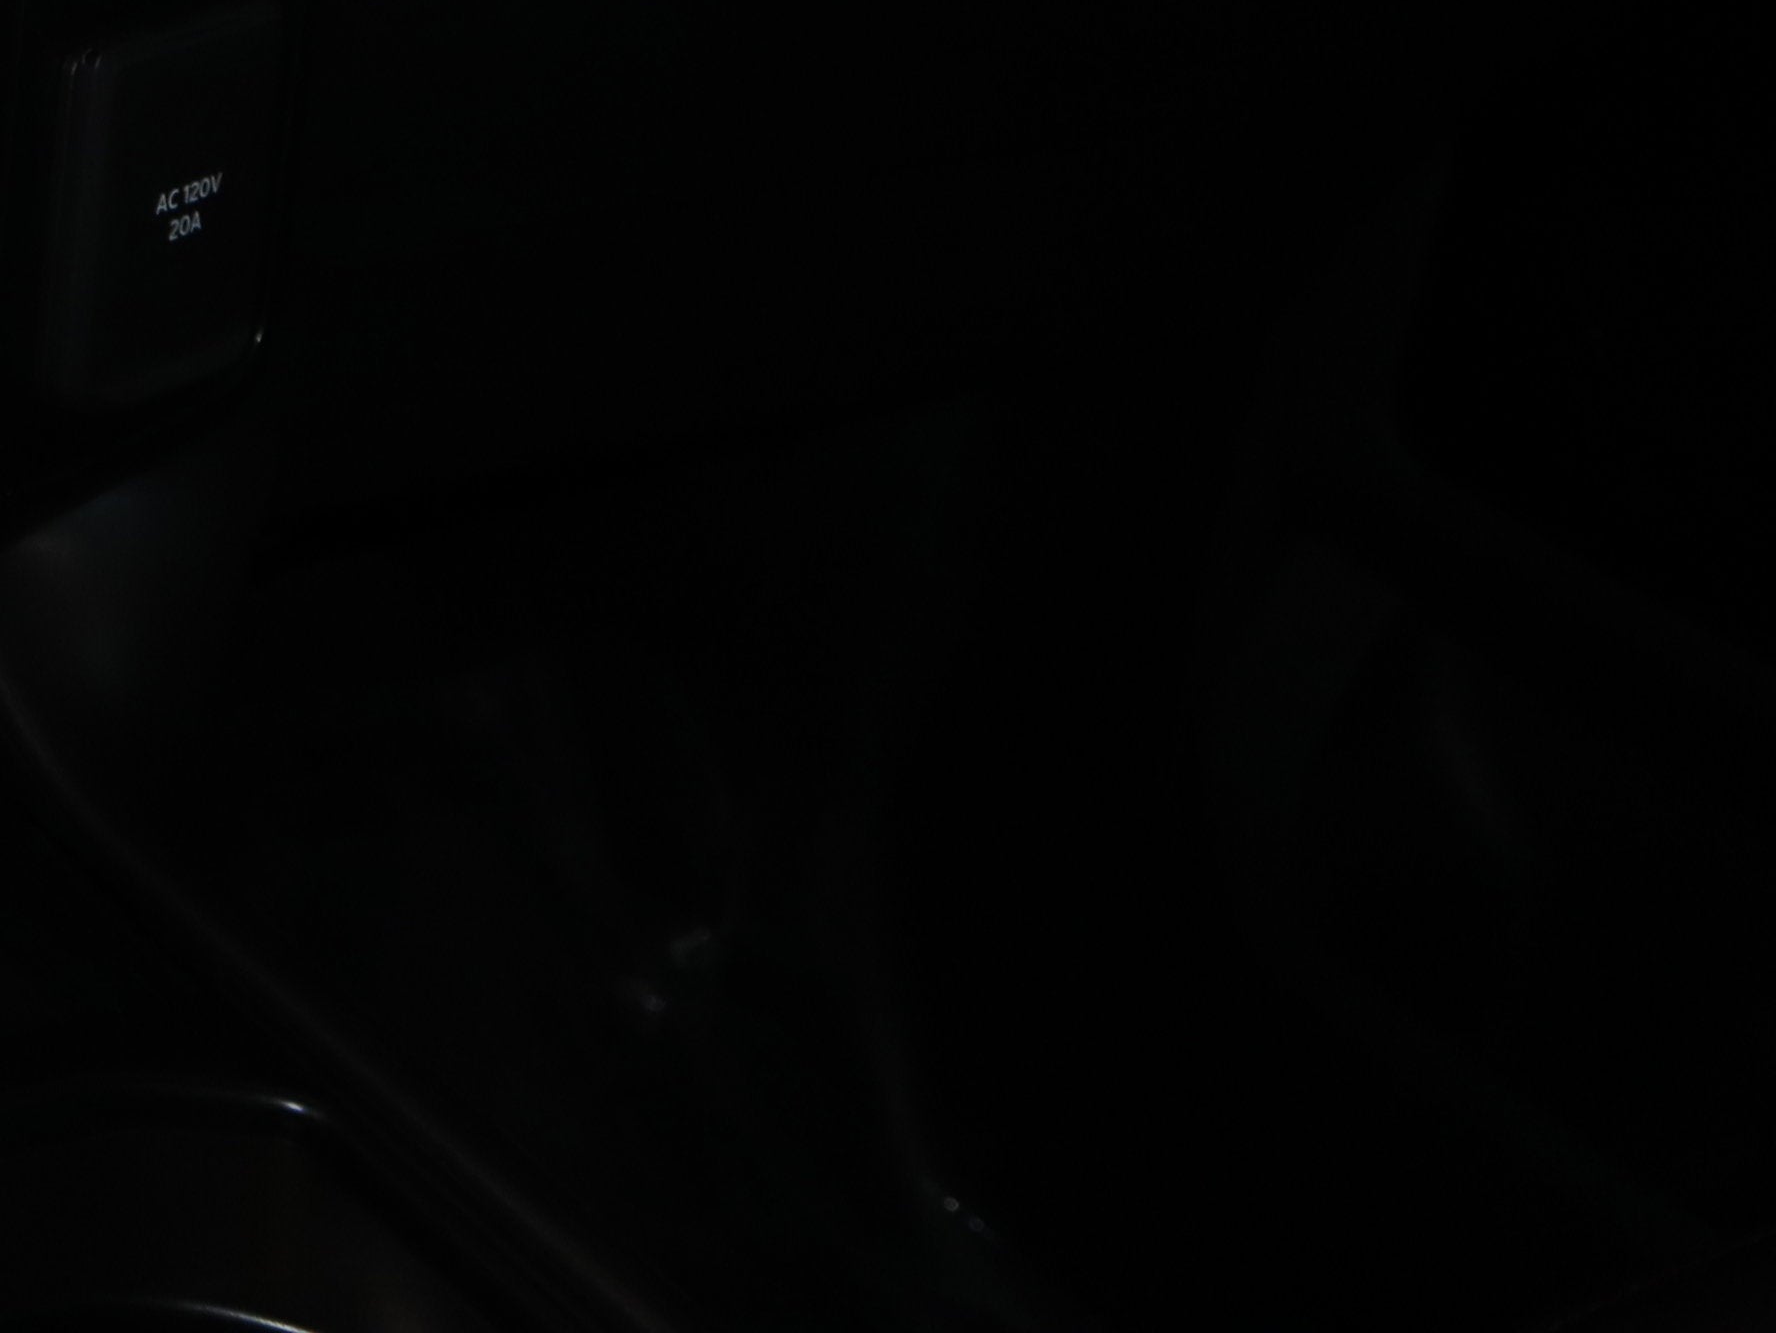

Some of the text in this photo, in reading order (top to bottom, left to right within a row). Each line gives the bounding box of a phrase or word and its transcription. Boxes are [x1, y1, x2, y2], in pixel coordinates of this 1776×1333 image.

[156, 171, 223, 216] AC 120V
[167, 211, 202, 241] 20A
